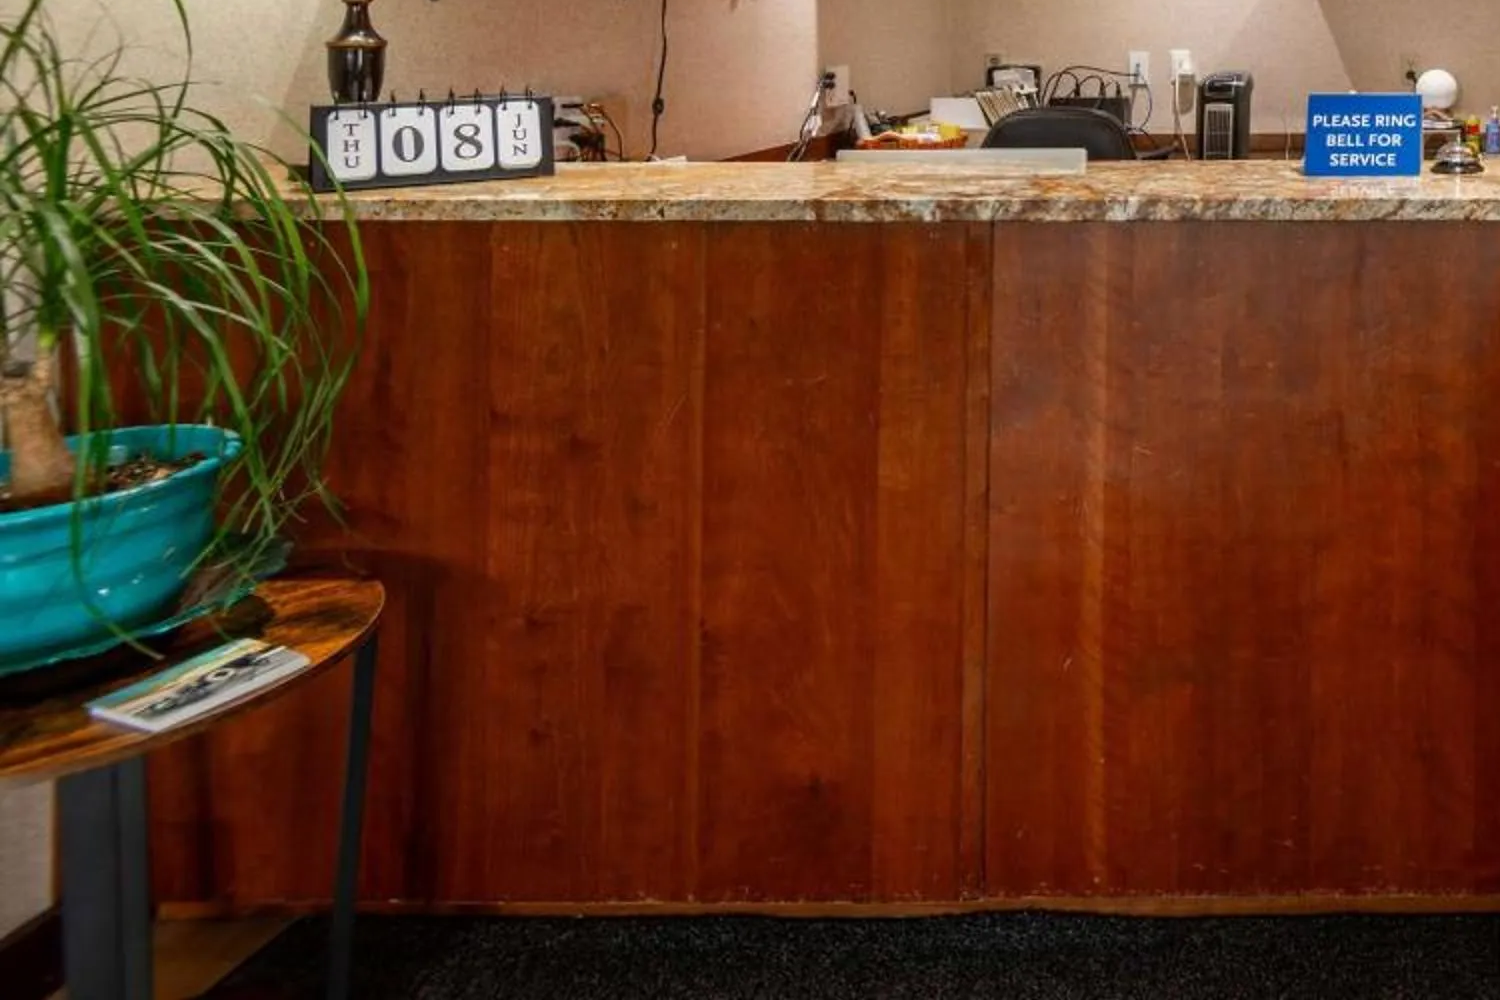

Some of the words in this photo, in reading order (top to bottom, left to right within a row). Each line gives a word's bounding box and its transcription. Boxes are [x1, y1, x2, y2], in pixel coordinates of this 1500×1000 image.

[1312, 114, 1371, 128] PLEASE
[1375, 114, 1417, 128] RING
[343, 123, 360, 169] THU
[512, 113, 528, 157] JUN
[1326, 133, 1365, 147] BELL
[1369, 133, 1402, 147] FOR
[1329, 153, 1397, 167] SERVICE
